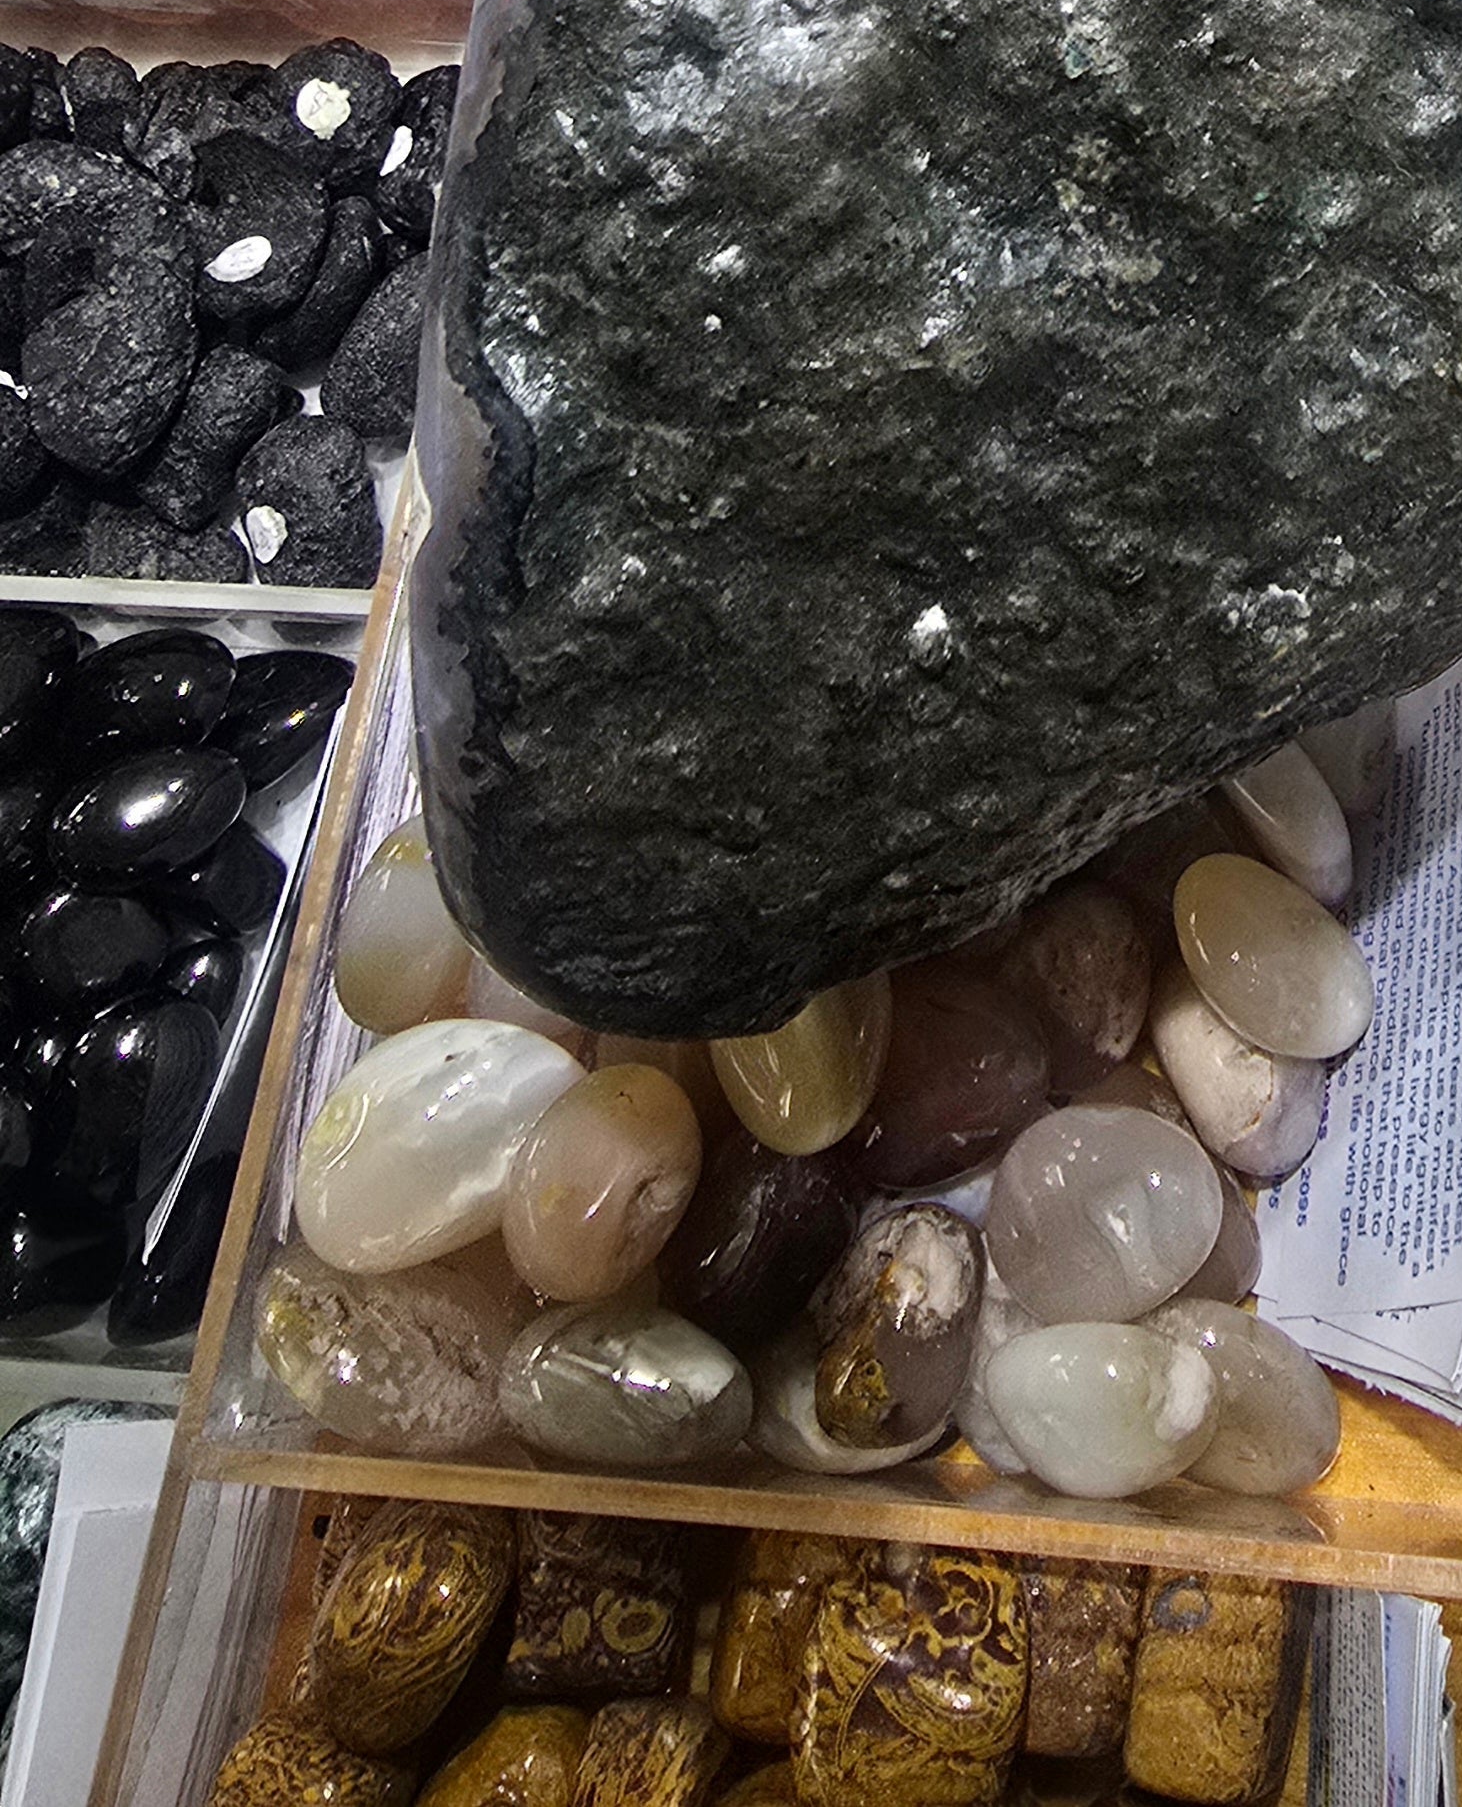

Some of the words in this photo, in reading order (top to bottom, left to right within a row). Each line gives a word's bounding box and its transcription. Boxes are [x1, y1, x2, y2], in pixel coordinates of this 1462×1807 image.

[1442, 686, 1453, 733] and
[1428, 704, 1440, 802] passion
[1396, 744, 1416, 877] comforting
[1438, 740, 1449, 831] nurture
[1448, 767, 1460, 854] Flower
[1413, 833, 1422, 851] is
[1427, 807, 1436, 832] to
[1420, 838, 1433, 922] pursue
[1436, 838, 1445, 880] our
[1362, 855, 1381, 948] moving
[1377, 845, 1396, 969] emotional
[1394, 883, 1406, 930] and
[1444, 863, 1457, 943] Agate
[1454, 942, 1462, 976] us
[1381, 938, 1402, 1072] grounding
[1413, 936, 1428, 1039] dreams
[1437, 950, 1451, 1057] inspires
[1451, 982, 1462, 1047] from
[1394, 986, 1411, 1106] maternal
[1426, 1006, 1436, 1038] Its
[1353, 1062, 1365, 1084] in
[1411, 1047, 1421, 1067] &
[1435, 1066, 1445, 1100] us
[1348, 1093, 1362, 1133] life
[1378, 1080, 1391, 1133] that
[1407, 1075, 1419, 1123] live
[1418, 1046, 1434, 1145] energy
[1447, 1054, 1460, 1128] fears
[1433, 1109, 1444, 1136] to
[1343, 1141, 1359, 1197] with
[1355, 1099, 1376, 1237] emotional
[1371, 1141, 1386, 1201] help
[1404, 1131, 1416, 1174] life
[1443, 1137, 1454, 1192] and
[1370, 1211, 1382, 1238] to
[1402, 1183, 1413, 1210] to
[1412, 1154, 1428, 1250] ignites
[1425, 1144, 1441, 1273] manifest
[1334, 1205, 1352, 1287] grace
[1397, 1220, 1410, 1265] the
[1411, 1260, 1420, 1278] a
